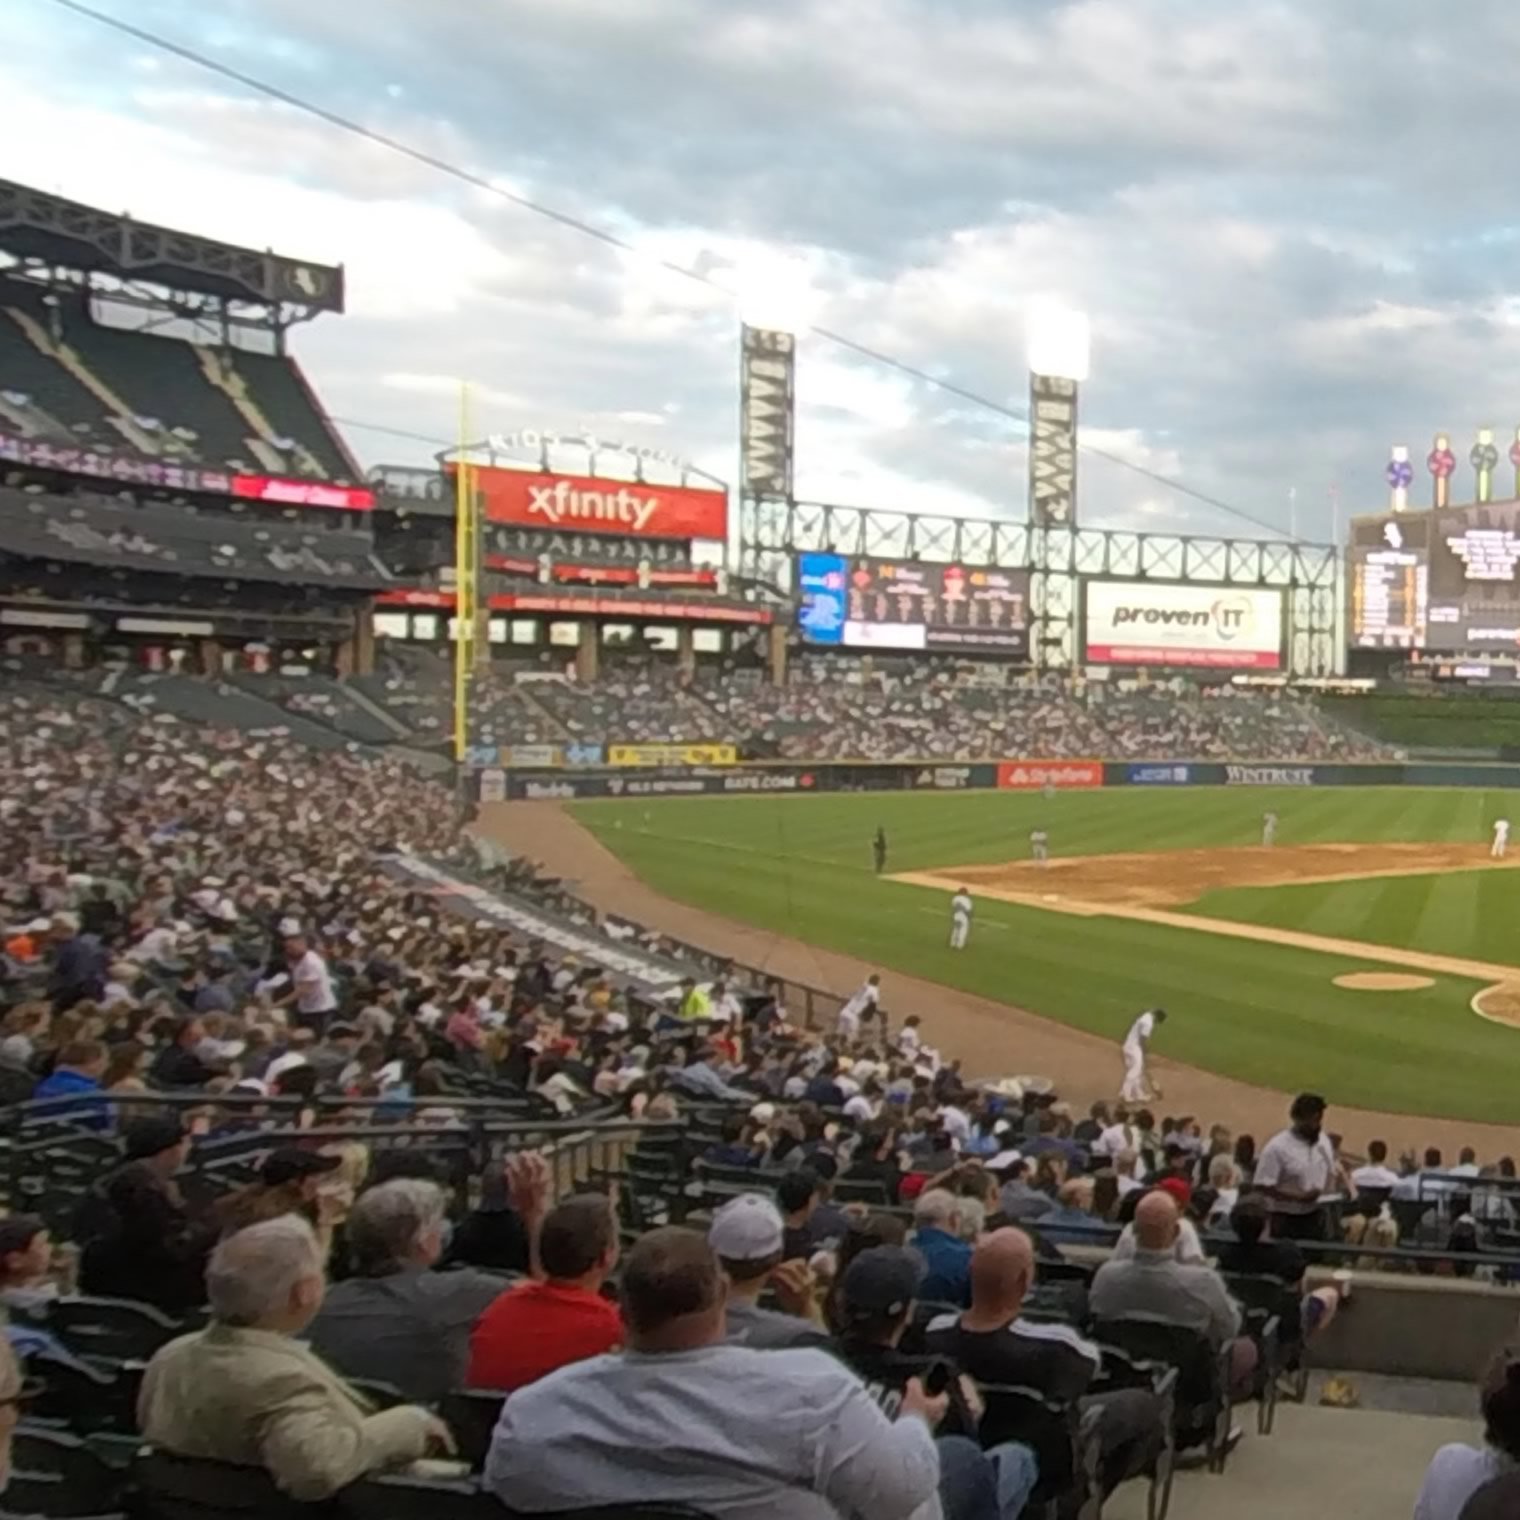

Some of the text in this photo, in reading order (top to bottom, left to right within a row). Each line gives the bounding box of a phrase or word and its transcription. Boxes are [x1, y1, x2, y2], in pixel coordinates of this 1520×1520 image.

[528, 480, 657, 530] xfinity
[1111, 606, 1245, 628] proven IT
